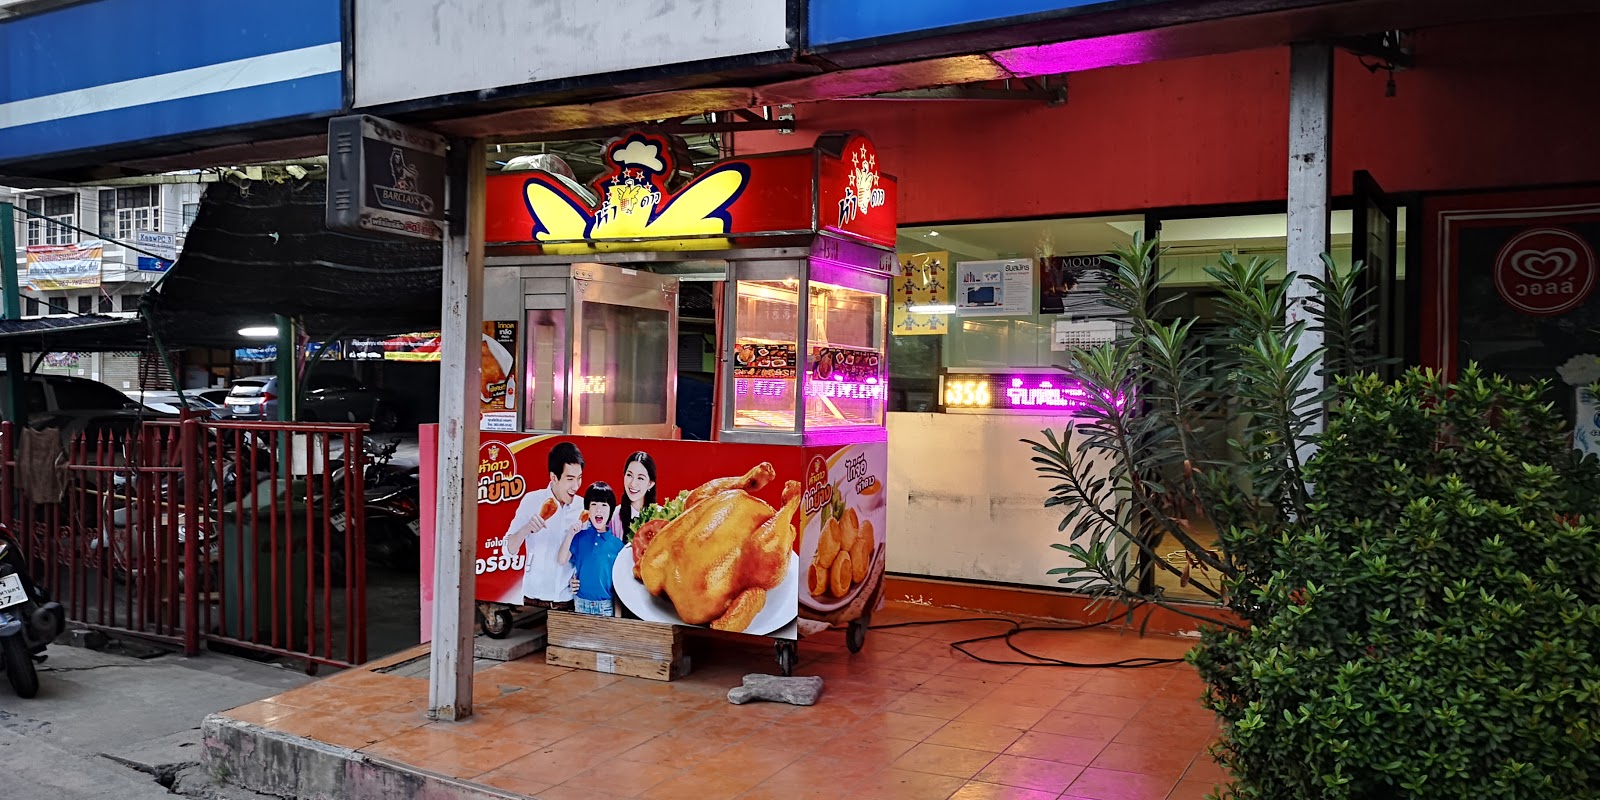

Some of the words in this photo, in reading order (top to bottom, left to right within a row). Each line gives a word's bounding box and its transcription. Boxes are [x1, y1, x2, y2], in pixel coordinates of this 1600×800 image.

[382, 189, 420, 205] BARCLAYS
[595, 201, 617, 229] ห้า
[640, 192, 661, 208] ดาว
[838, 187, 858, 229] ห้า
[870, 188, 885, 208] ดาว
[1061, 257, 1101, 267] MOOD
[1515, 276, 1576, 297] วอลล์
[478, 458, 510, 474] ห้าดาว
[477, 473, 523, 500] ก่ย่าง
[809, 472, 825, 485] ห้าดาว
[856, 475, 876, 495] ห้าดาว
[804, 483, 831, 511] ไก่ย่าง
[475, 548, 534, 575] อร่อย!
